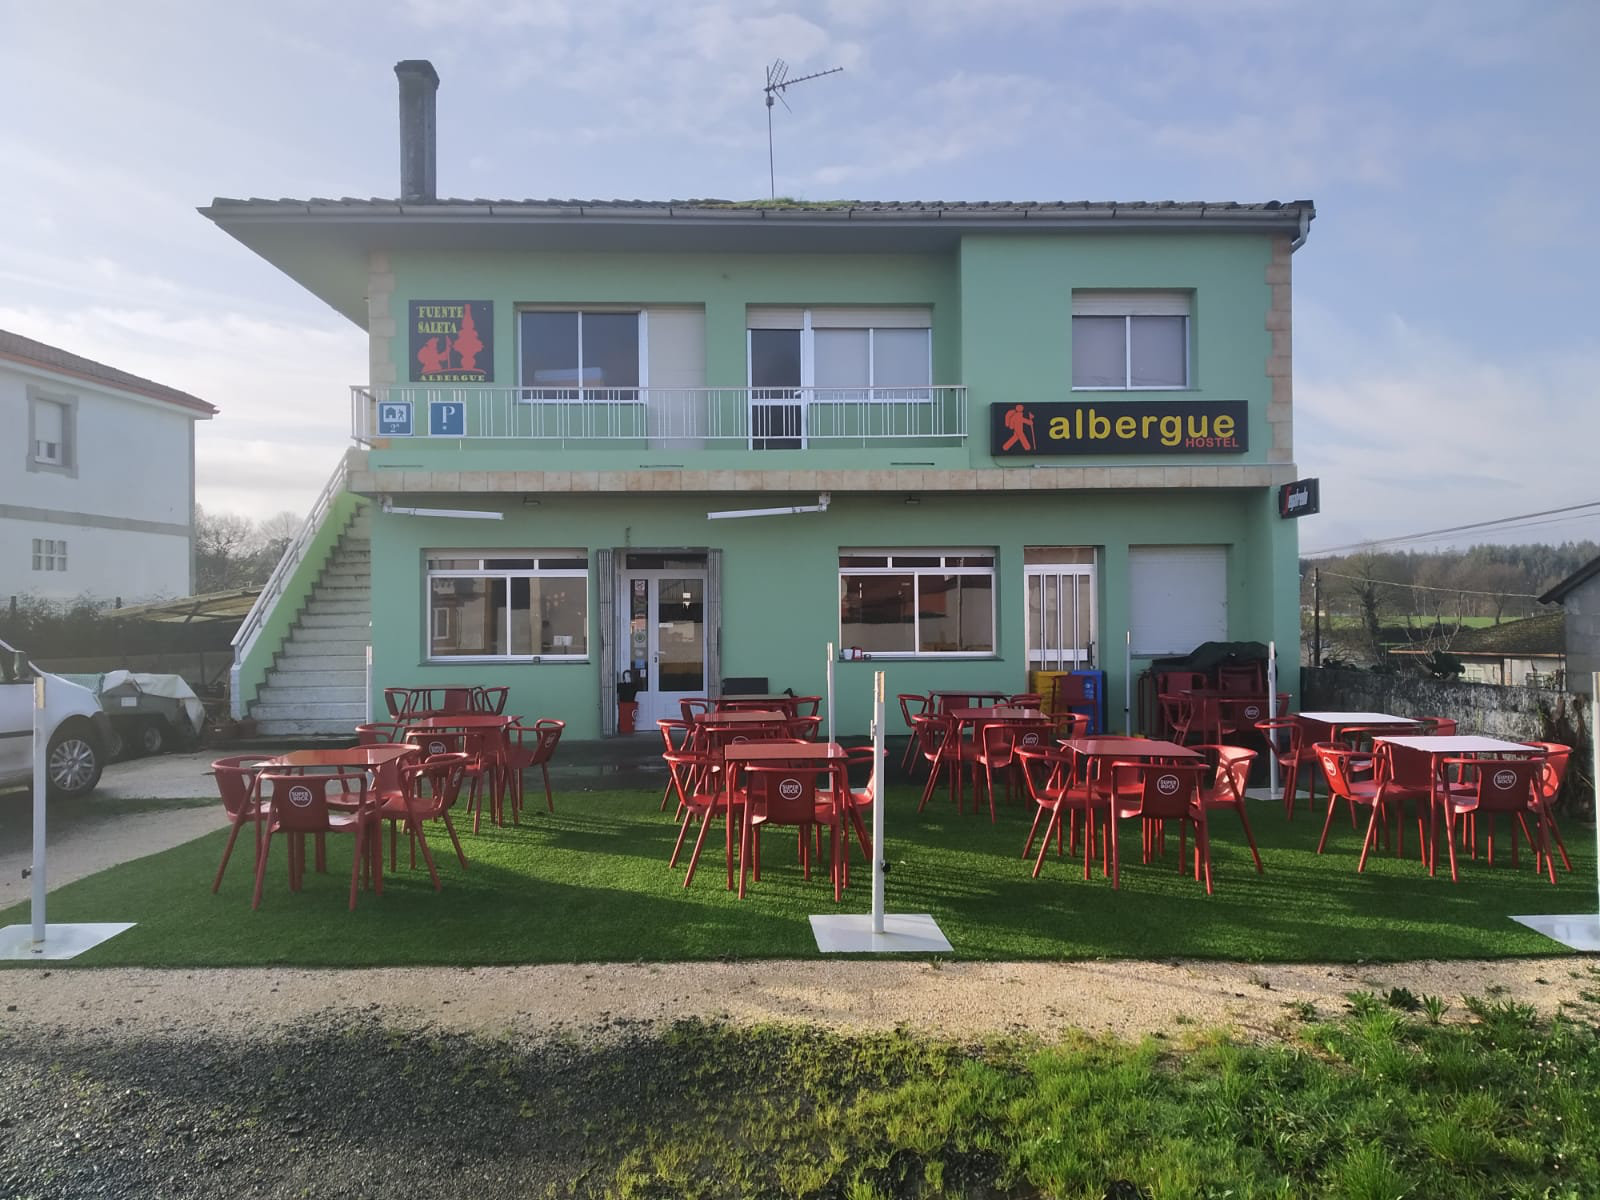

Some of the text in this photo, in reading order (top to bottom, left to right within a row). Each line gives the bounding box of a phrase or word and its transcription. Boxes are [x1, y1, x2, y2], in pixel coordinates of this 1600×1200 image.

[417, 306, 463, 318] FUENTE
[417, 322, 457, 334] SALETA
[1049, 408, 1235, 446] albergue
[1185, 437, 1239, 448] HOSTEL
